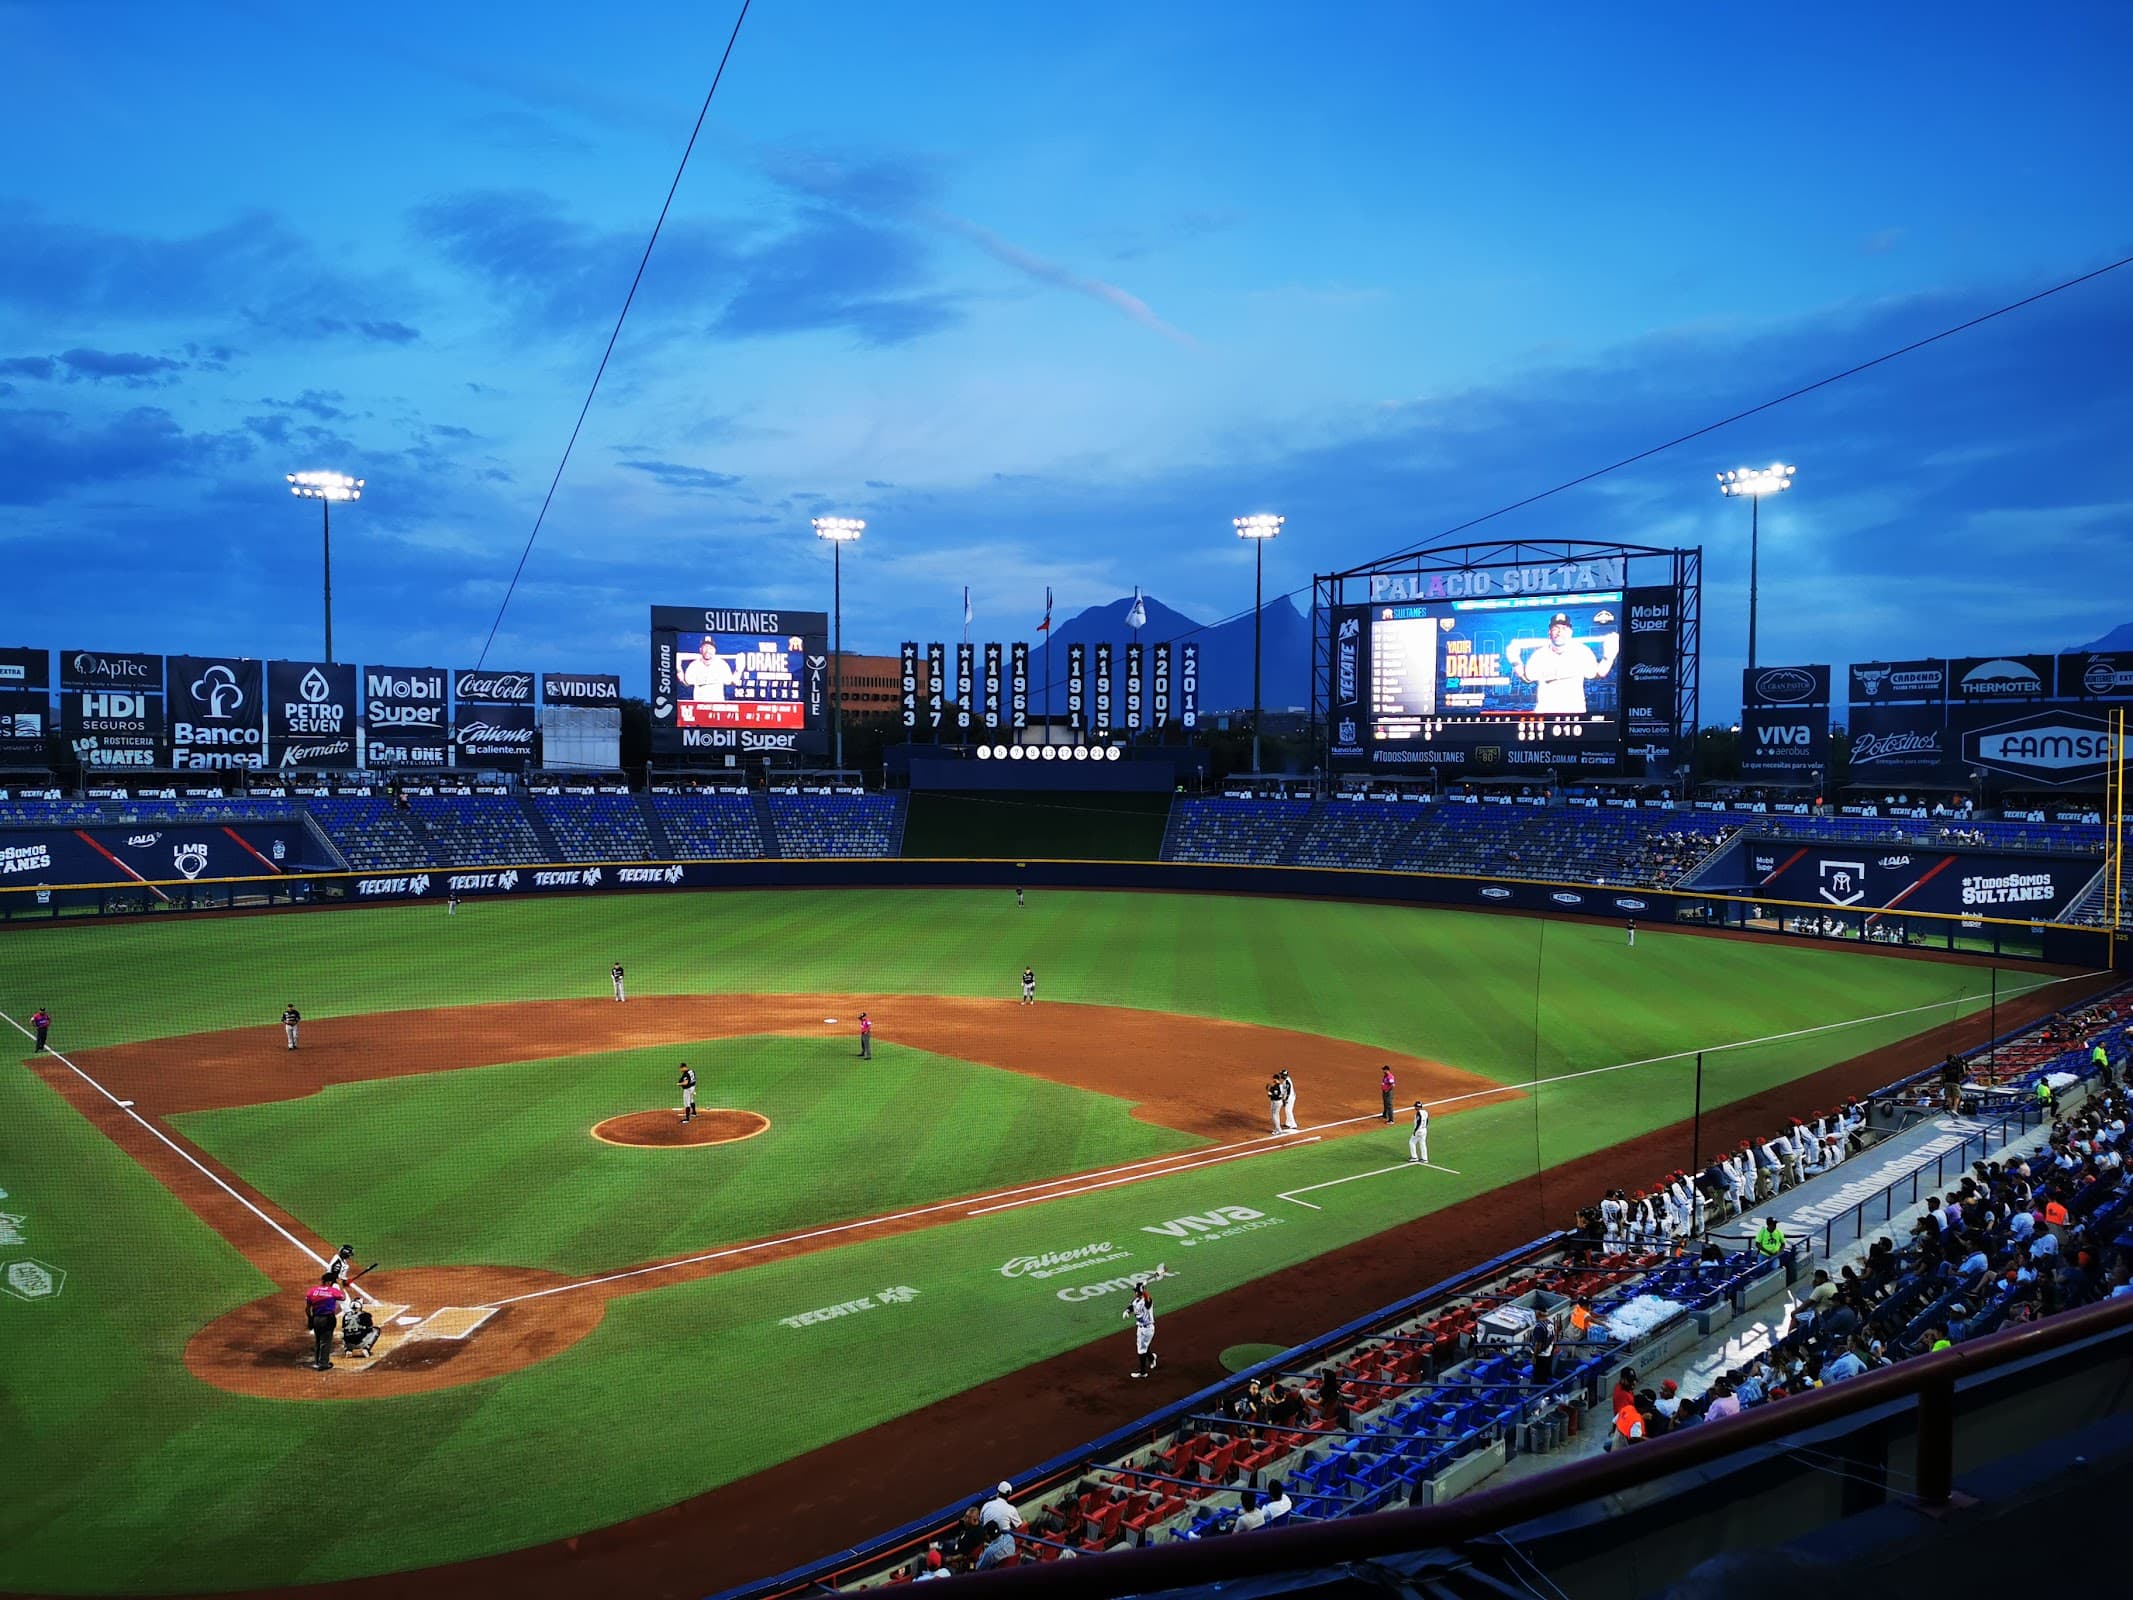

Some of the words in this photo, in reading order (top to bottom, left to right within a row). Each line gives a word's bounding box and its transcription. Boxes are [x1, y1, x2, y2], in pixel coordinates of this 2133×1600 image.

[1370, 572, 1491, 602] PALACIO
[1502, 558, 1625, 593] SULTAN
[1631, 604, 1669, 618] Mobil
[705, 611, 778, 633] SULTANES
[1631, 618, 1668, 631] Super
[96, 659, 148, 679] ApTec
[658, 644, 671, 694] Soriana
[747, 652, 788, 672] DRAKE
[1340, 642, 1354, 700] TECATE
[1446, 654, 1500, 677] DRAKE
[1629, 663, 1670, 676] Caliente
[368, 675, 441, 699] Mobil
[456, 673, 533, 699] Coca-Cola
[559, 681, 618, 698] VIDUSA
[903, 659, 916, 727] 1943
[929, 659, 943, 728] 1947
[957, 660, 971, 728] 1948
[985, 660, 999, 728] 1949
[1013, 659, 1026, 727] 1962
[1069, 660, 1082, 728] 1991
[1097, 660, 1110, 728] 1995
[1127, 660, 1141, 728] 1996
[1155, 660, 1168, 728] 2007
[1183, 659, 1196, 728] 2018
[1960, 681, 2042, 693] THERMOTEK
[82, 694, 145, 718] HDI
[285, 703, 344, 720] PETRO
[368, 701, 441, 727] Super
[1628, 707, 1653, 717] INDE
[82, 721, 145, 731] SEGUROS
[174, 722, 260, 745] Banco
[289, 719, 340, 733] SEVEN
[457, 721, 534, 744] Caliente
[1628, 726, 1650, 734] Nuevo
[1651, 725, 1670, 734] León
[72, 736, 99, 752] LOS
[104, 737, 154, 746] ROSTICERIA
[476, 745, 531, 755] caliente.mx
[682, 729, 736, 747] Mobil
[740, 731, 795, 750] Super
[1850, 730, 1938, 764] Potosinos
[1999, 736, 2113, 758] FAMSA
[90, 750, 155, 765] CUATES
[172, 748, 263, 769] Famsa
[368, 742, 408, 761] CAR
[411, 746, 444, 761] ONE
[1775, 746, 1810, 756] aerobus
[173, 843, 208, 857] LMB
[448, 873, 496, 890] TECATE
[534, 871, 582, 886] TECATE
[616, 868, 664, 882] TECATE
[356, 877, 408, 895] TECATE
[1962, 885, 2055, 905] SULTANES
[1218, 1217, 1285, 1237] aerobus
[994, 1241, 1113, 1278] Caliente
[1056, 1264, 1174, 1302] Comex
[778, 1297, 878, 1329] TECATE
